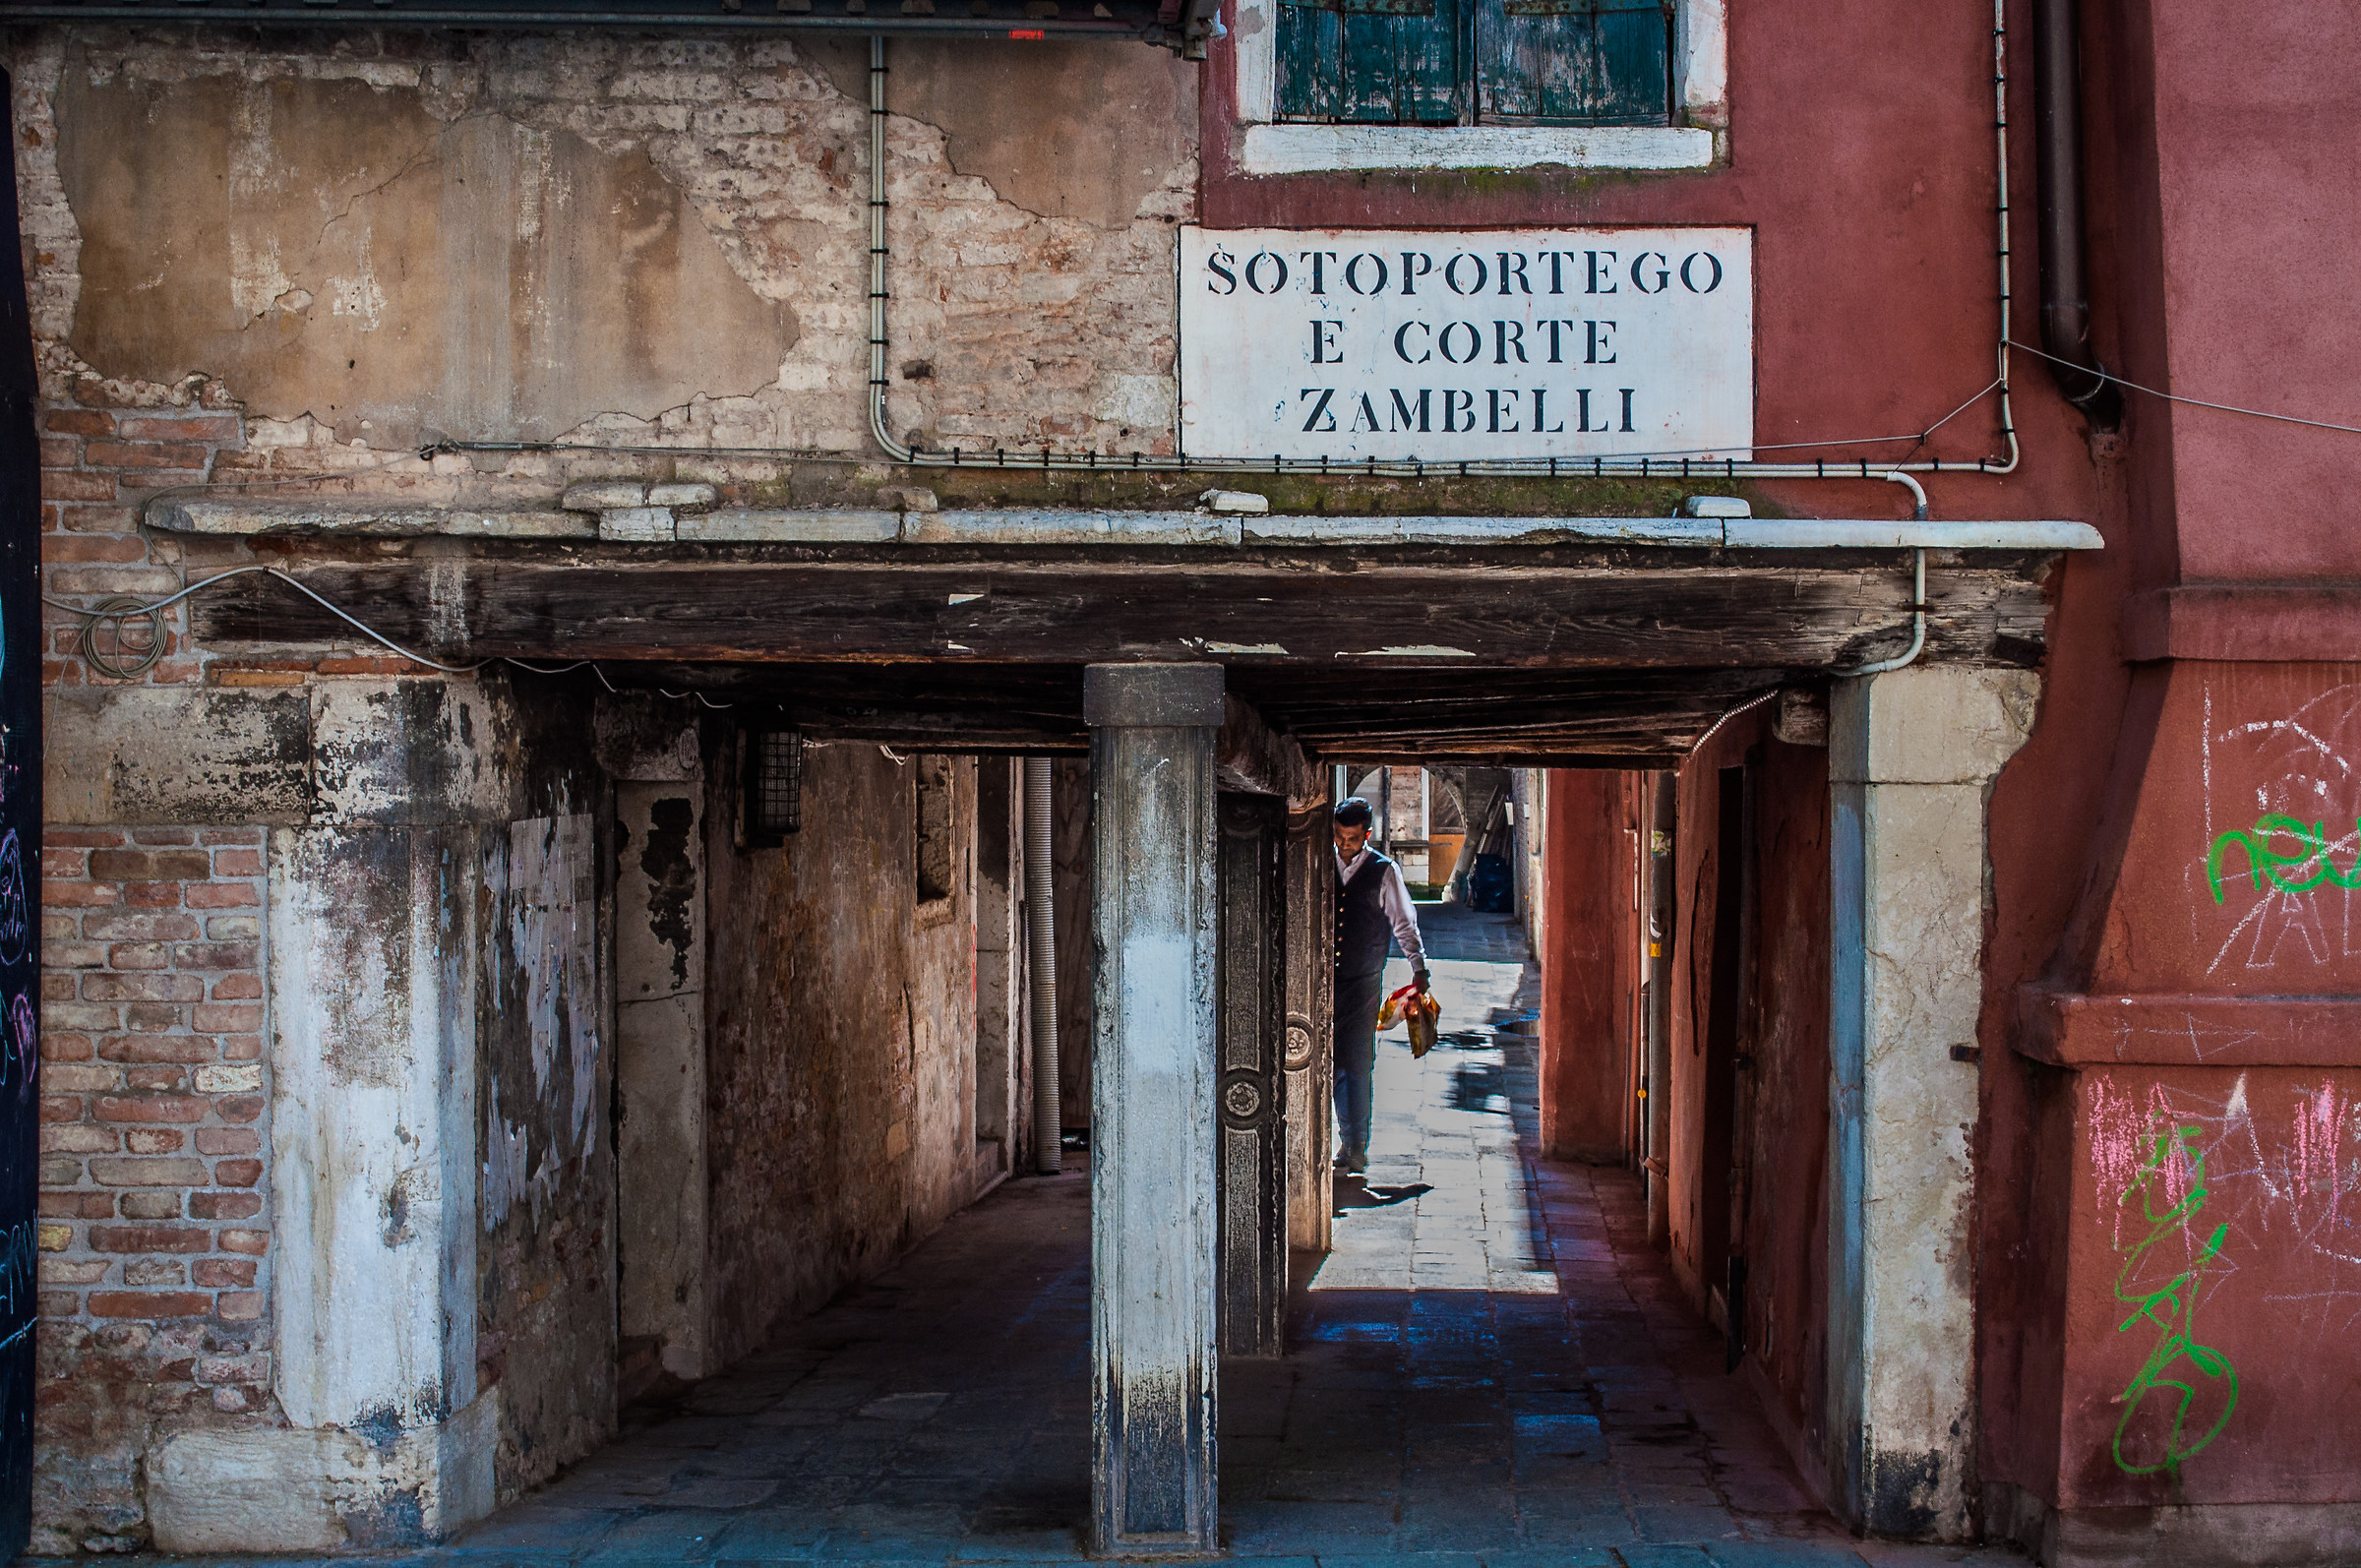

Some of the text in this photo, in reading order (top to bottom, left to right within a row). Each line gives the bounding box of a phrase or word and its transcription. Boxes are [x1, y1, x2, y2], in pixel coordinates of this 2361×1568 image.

[1207, 250, 1724, 296] SOTOPORTEGO
[1308, 320, 1618, 364] E CORTE
[1300, 388, 1637, 433] ZAMBELLI
